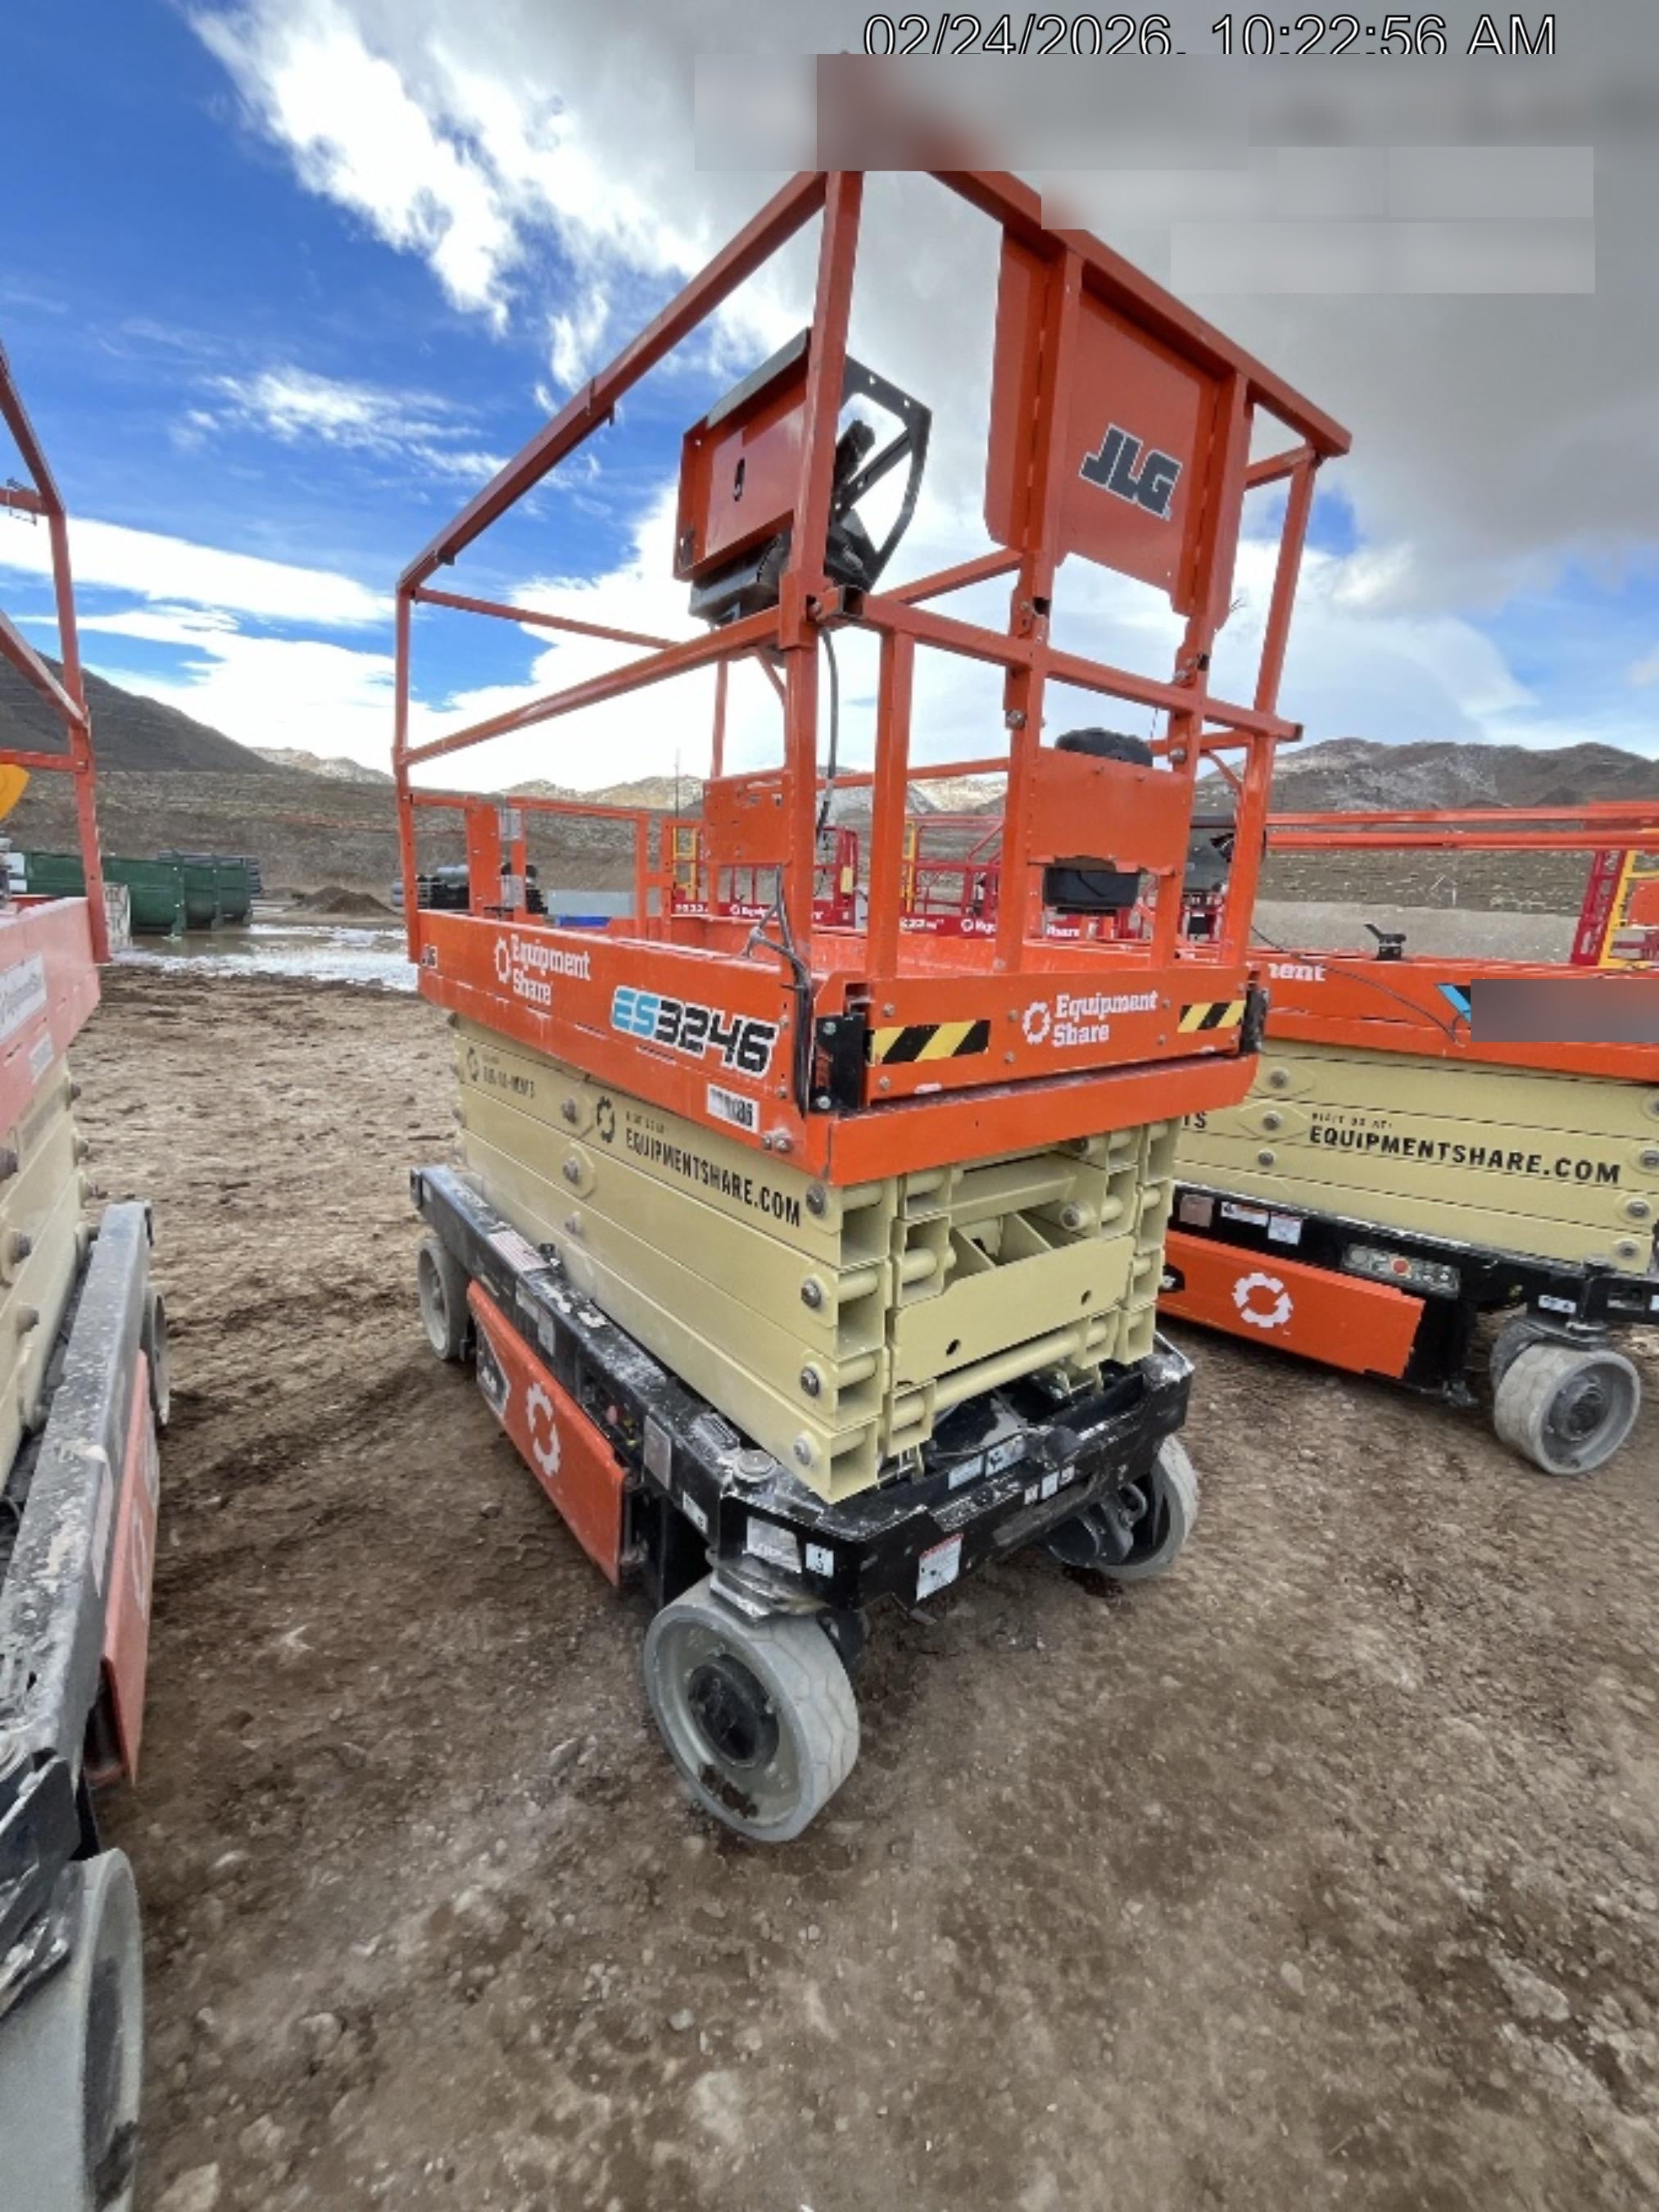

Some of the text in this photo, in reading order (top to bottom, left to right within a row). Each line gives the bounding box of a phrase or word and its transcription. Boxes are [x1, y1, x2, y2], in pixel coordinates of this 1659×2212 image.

[1078, 422, 1183, 521] JLG
[510, 933, 591, 981] Equipment
[513, 968, 551, 1005] Share
[1054, 990, 1158, 1022] Equipment
[611, 985, 779, 1079] ES3246
[1052, 1022, 1109, 1047] Share
[626, 1127, 800, 1227] EQUIPMENTSHARE.COM
[1310, 1125, 1621, 1185] EQUIPMENTSHARE.COM
